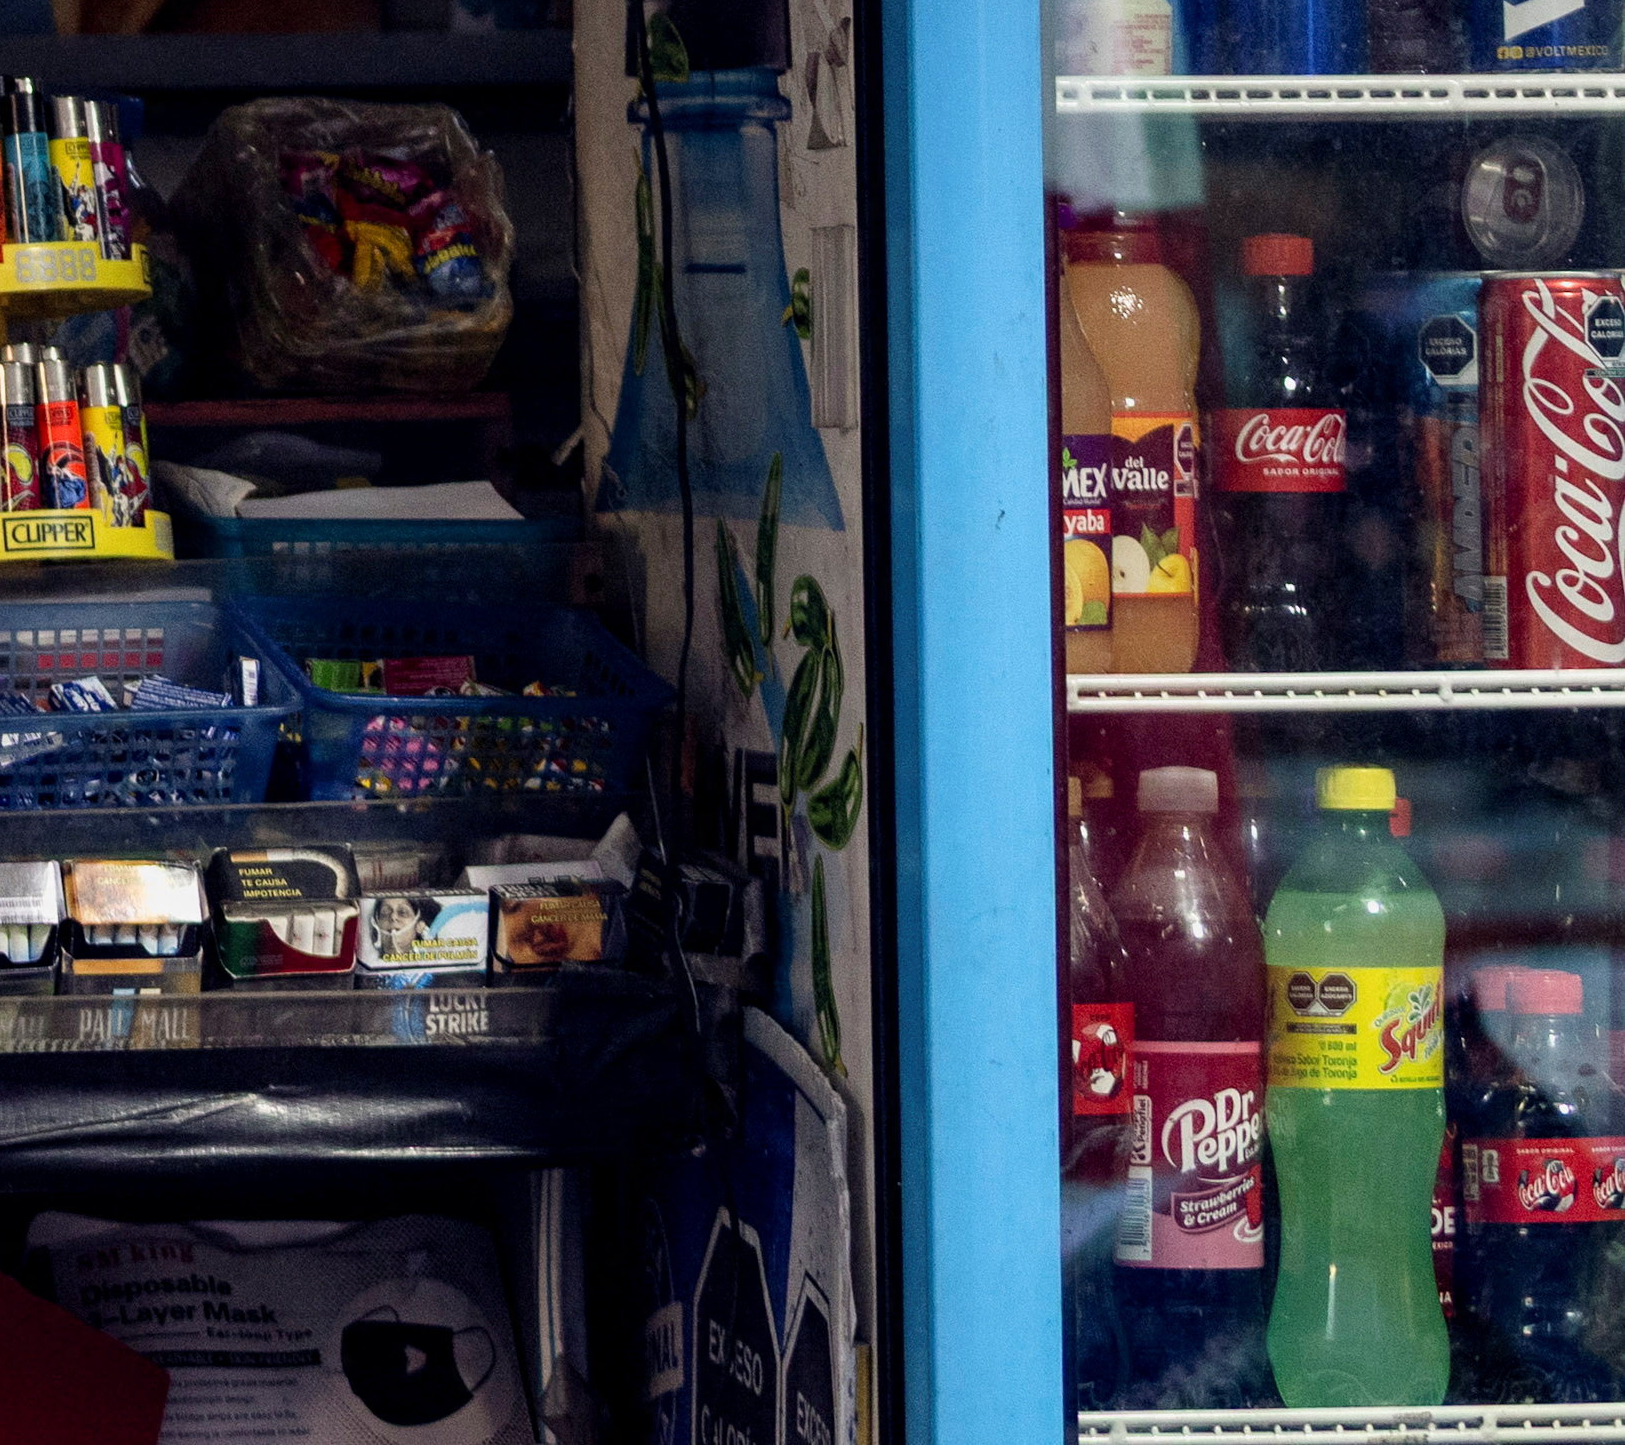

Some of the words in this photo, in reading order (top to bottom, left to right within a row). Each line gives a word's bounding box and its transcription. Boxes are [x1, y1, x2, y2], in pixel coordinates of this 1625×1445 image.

[11, 521, 89, 546] CLIPPER
[426, 1011, 489, 1036] STRIKE
[1215, 1088, 1255, 1128] Dr
[1163, 1107, 1263, 1175] Peppe
[1179, 1178, 1253, 1216] Strawberries
[1198, 1204, 1241, 1226] Cream
